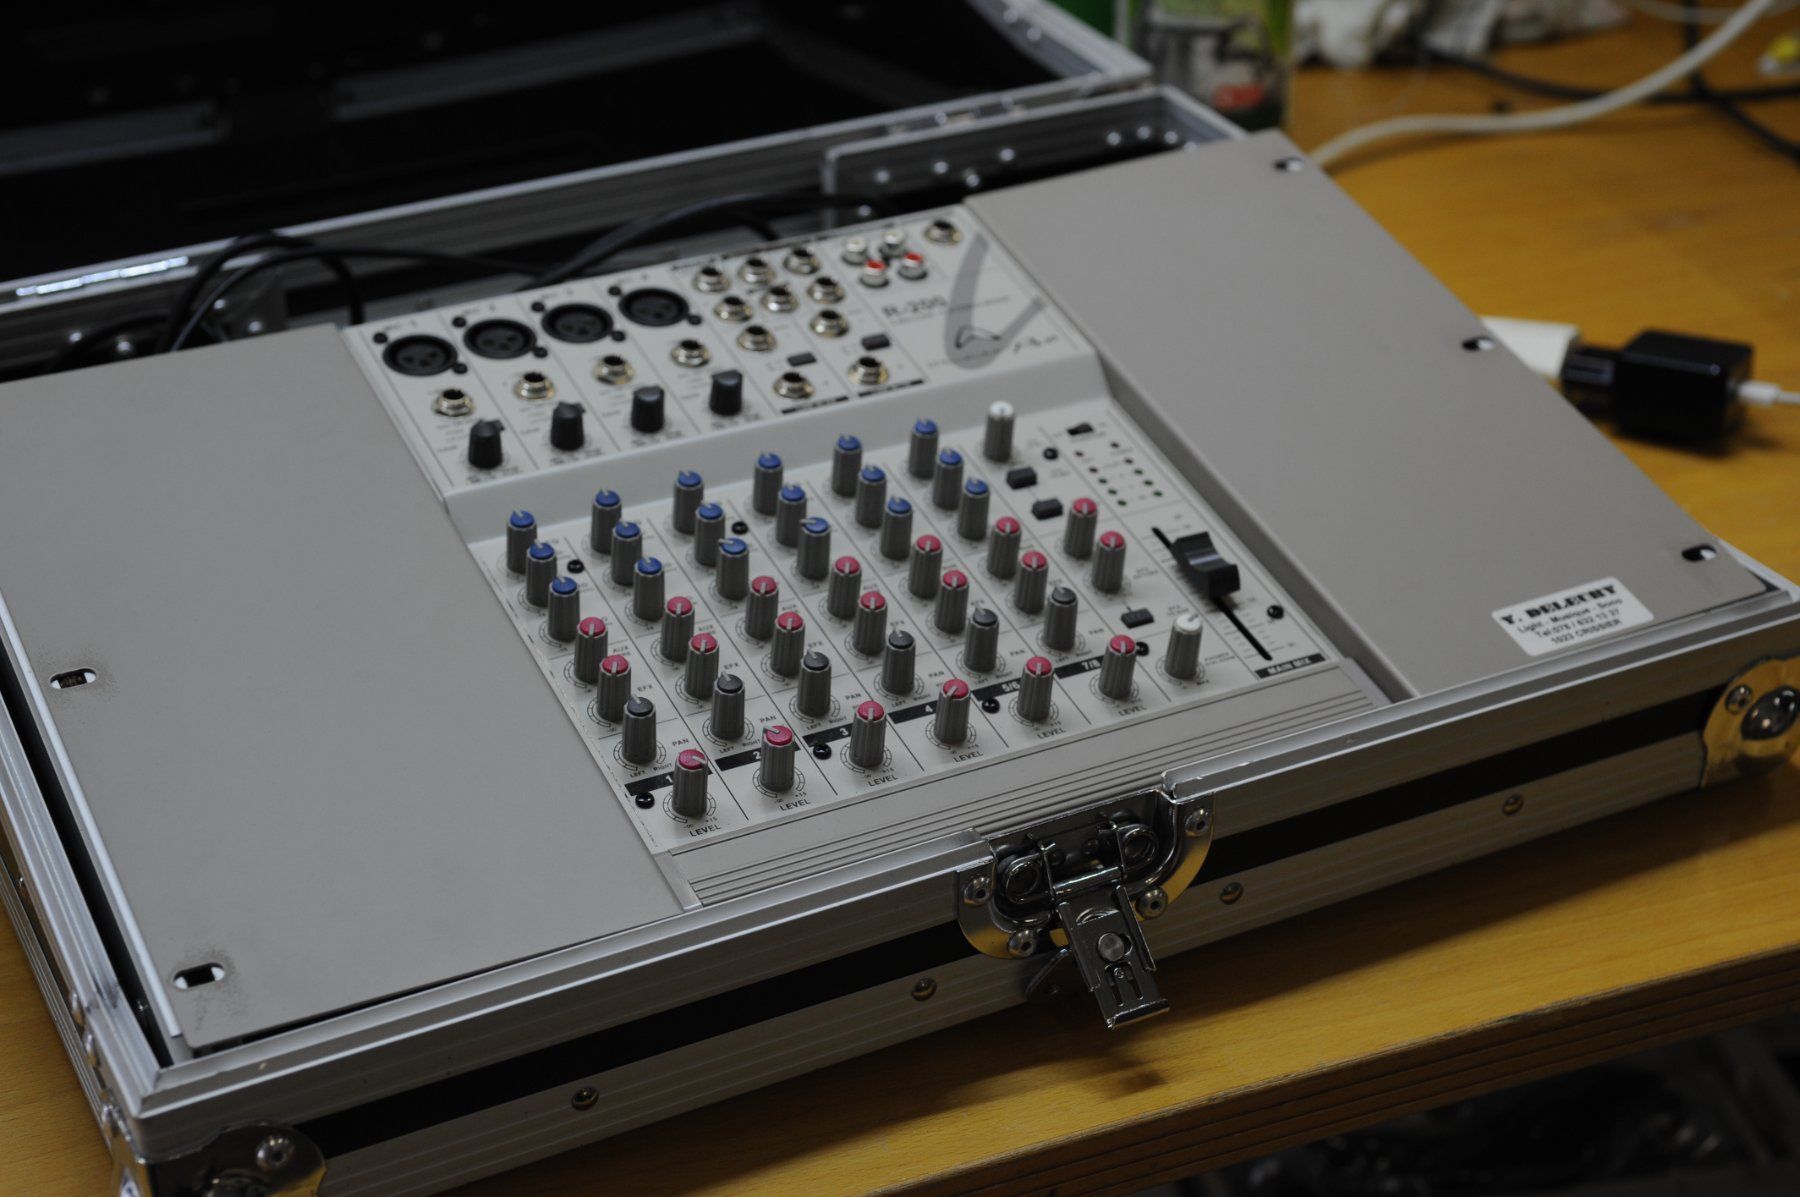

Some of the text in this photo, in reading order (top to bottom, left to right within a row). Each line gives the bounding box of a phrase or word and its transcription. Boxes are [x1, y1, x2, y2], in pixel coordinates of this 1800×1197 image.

[1001, 681, 1020, 693] 5/6
[925, 704, 933, 713] 4
[1118, 705, 1148, 717] LEVEL
[839, 727, 849, 736] 3
[1037, 727, 1066, 740] LEVEL
[672, 738, 689, 747] PAN
[752, 751, 761, 760] 2
[953, 750, 984, 763] LEVEL
[630, 770, 646, 779] LEFT
[868, 774, 899, 787] LEVEL
[780, 799, 811, 812] LEVEL
[689, 824, 721, 837] LEVEL
